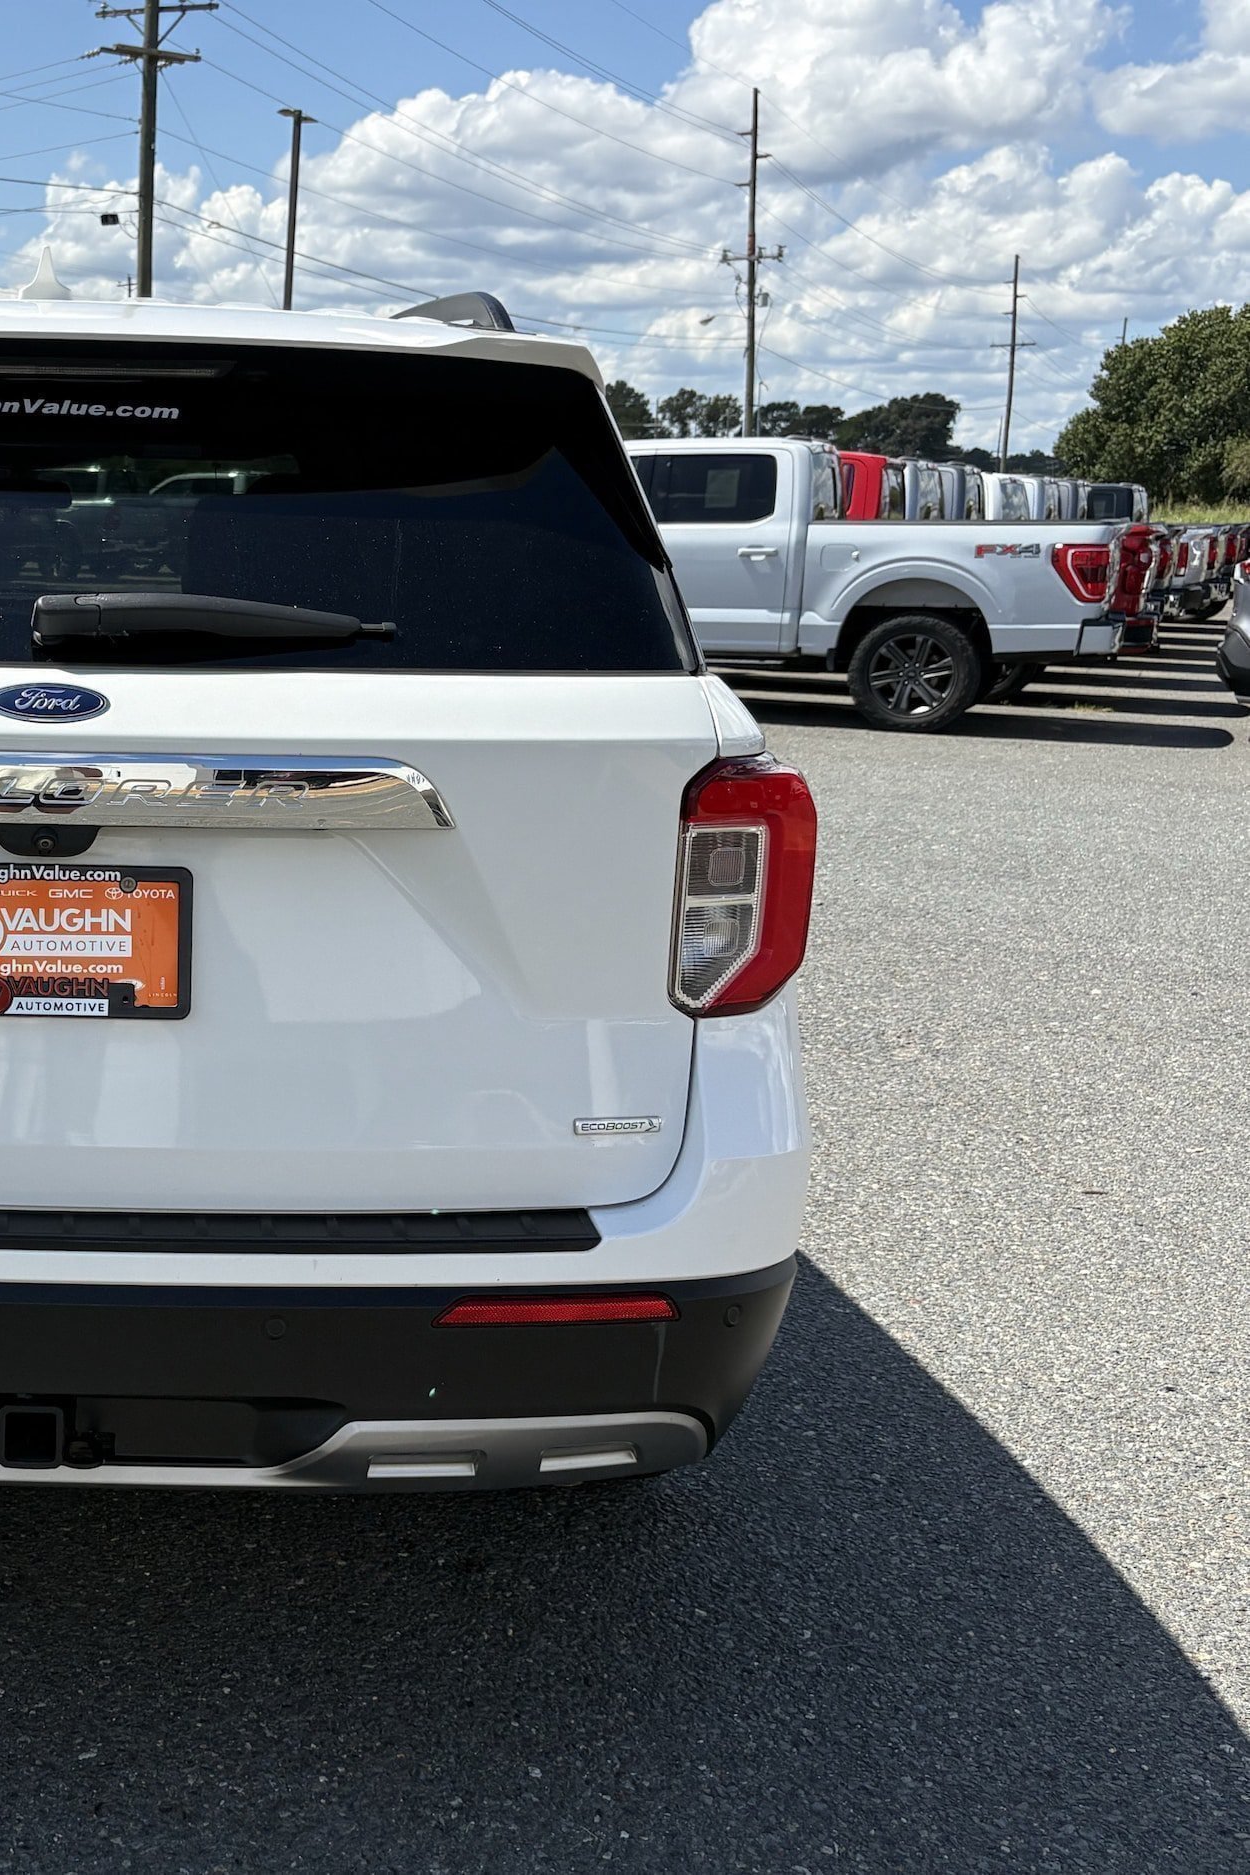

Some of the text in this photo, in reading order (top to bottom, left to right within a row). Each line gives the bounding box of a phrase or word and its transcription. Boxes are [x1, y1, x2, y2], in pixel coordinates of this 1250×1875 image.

[974, 543, 1041, 558] FX4
[14, 687, 82, 711] Ford
[48, 888, 93, 898] GMC
[0, 907, 131, 932] VAUGHN
[10, 940, 127, 952] AUTOMOTIVE
[7, 975, 109, 997] VAUGHN
[15, 1001, 105, 1013] AUTOMOTIVE
